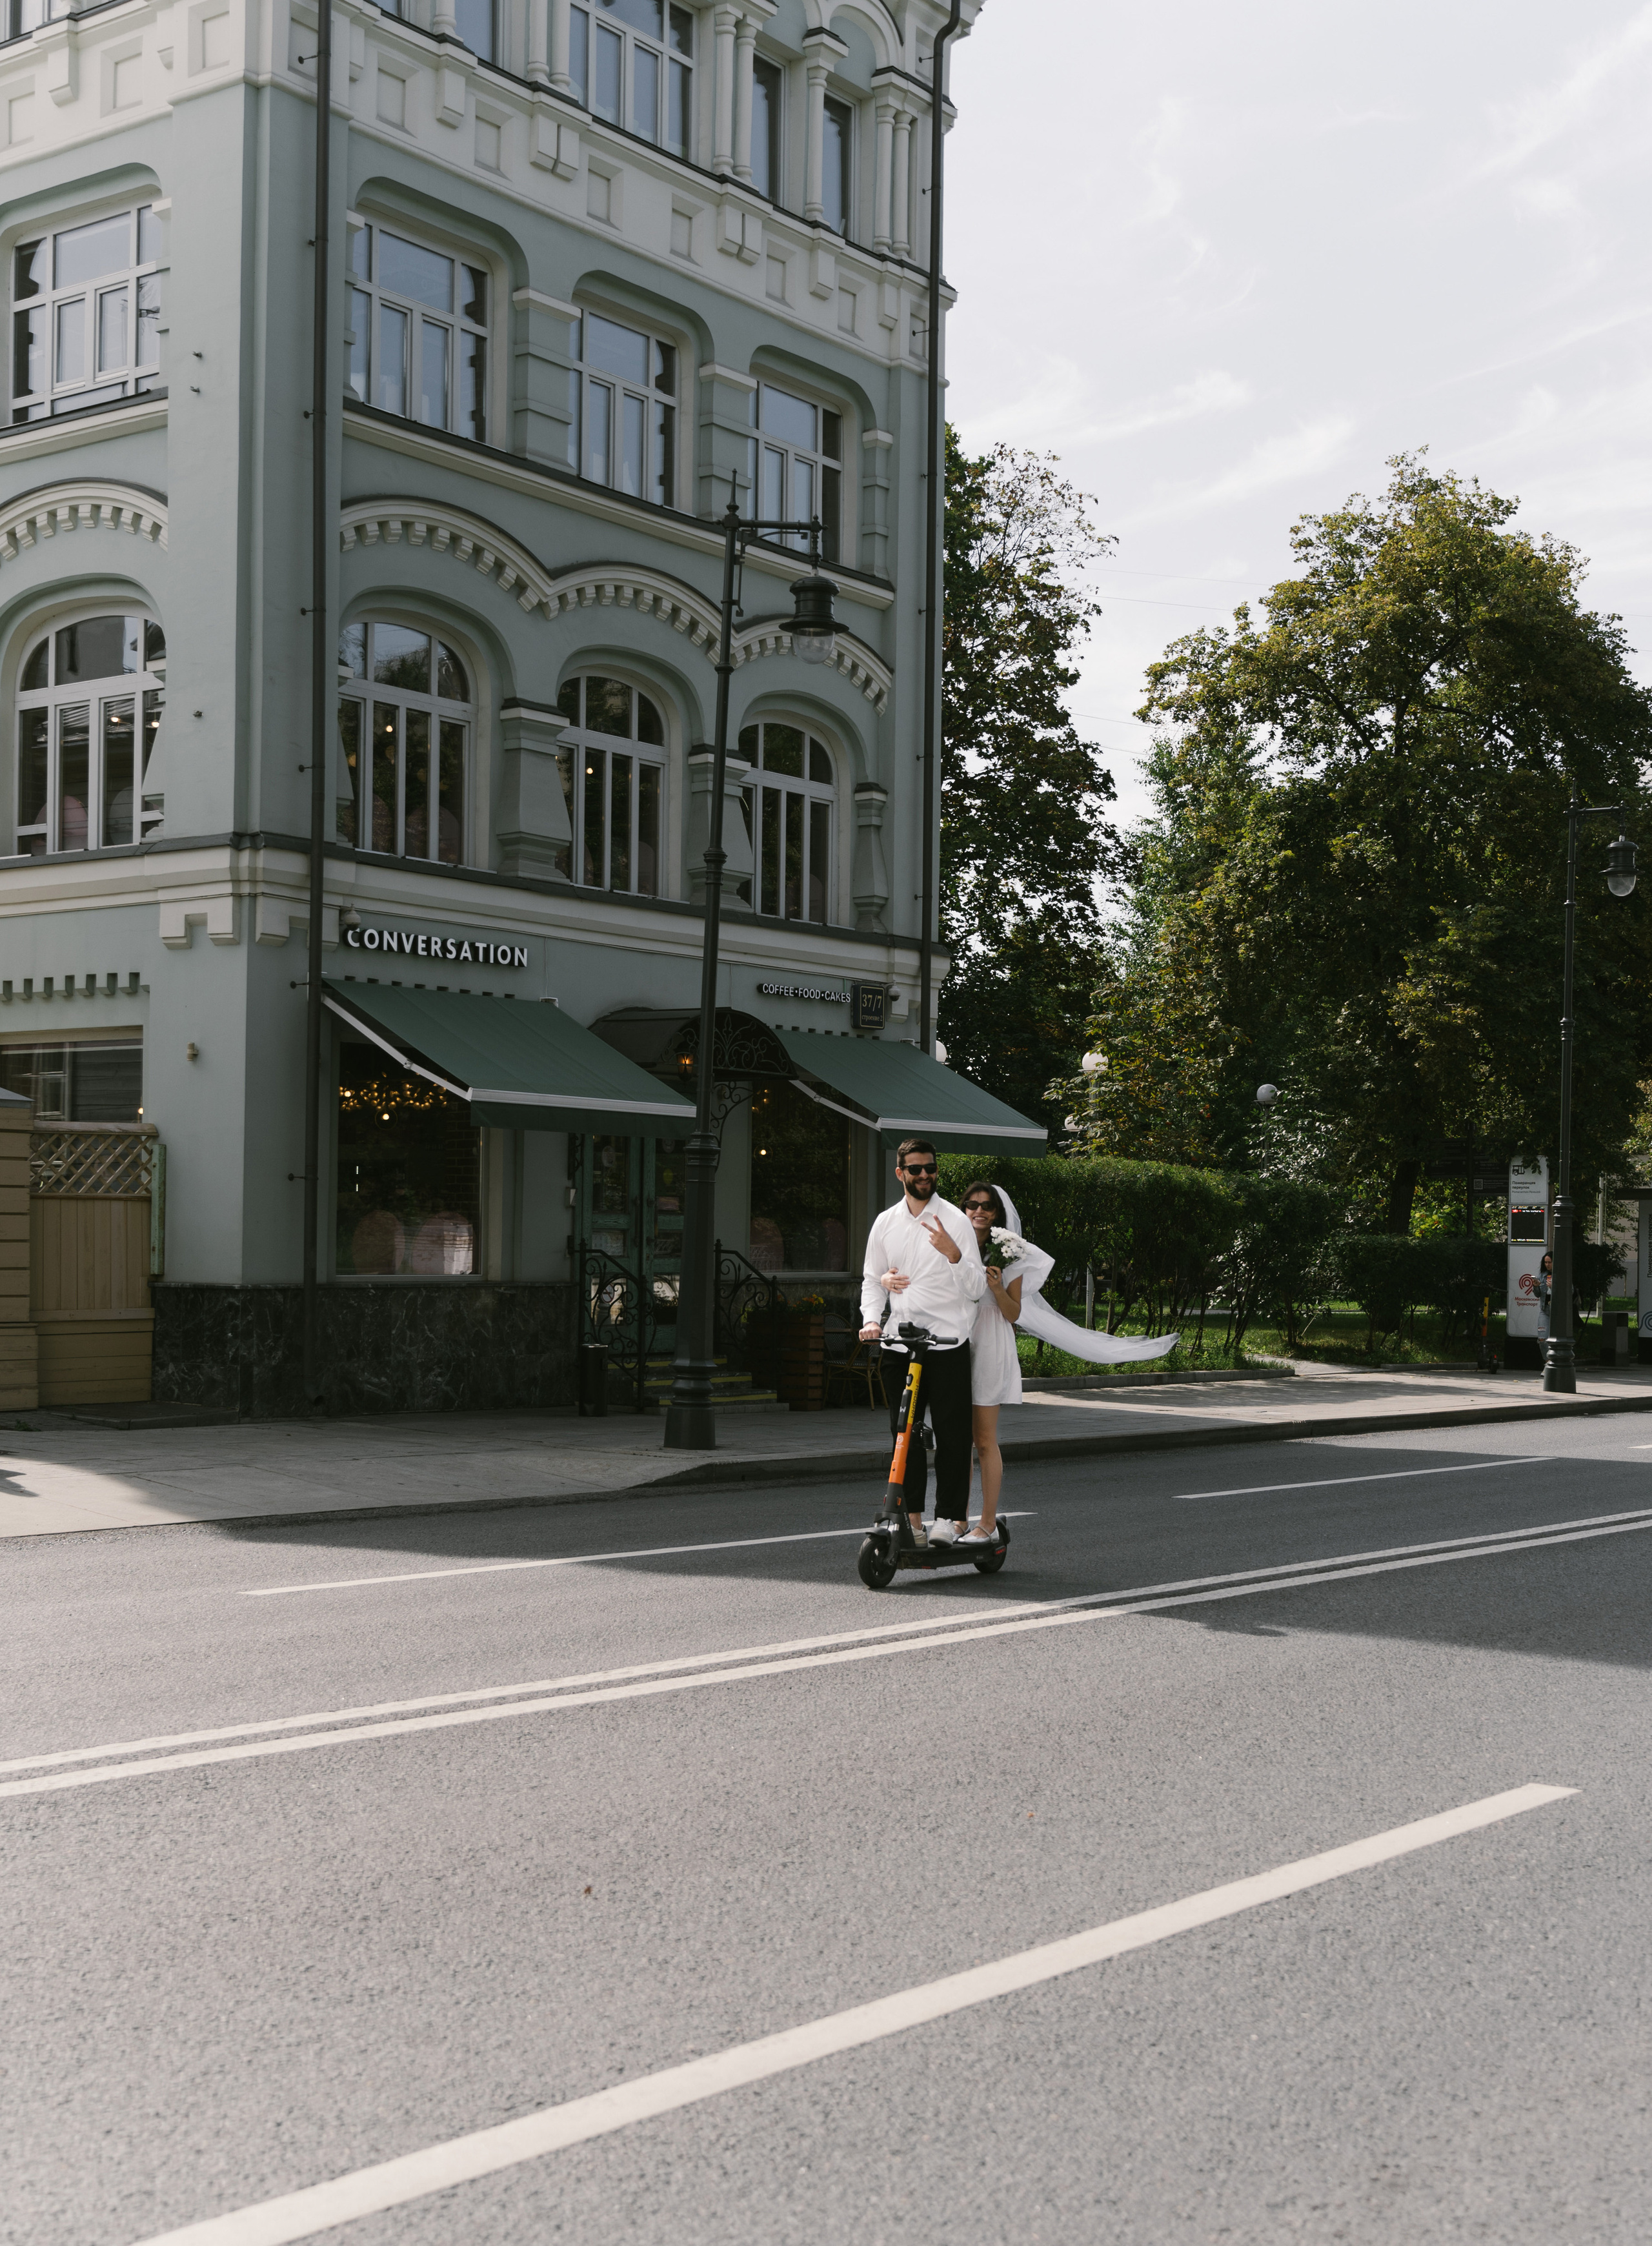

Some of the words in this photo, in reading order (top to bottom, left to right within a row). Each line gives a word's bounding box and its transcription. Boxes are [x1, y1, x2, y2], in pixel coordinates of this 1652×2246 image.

[347, 927, 528, 967] CONVERSATION
[762, 983, 794, 997] COFFEE
[798, 987, 820, 999] FOOD
[825, 991, 851, 1003] CAKES
[862, 994, 882, 1012] 37/7
[910, 1385, 919, 1419] WHOOSH
